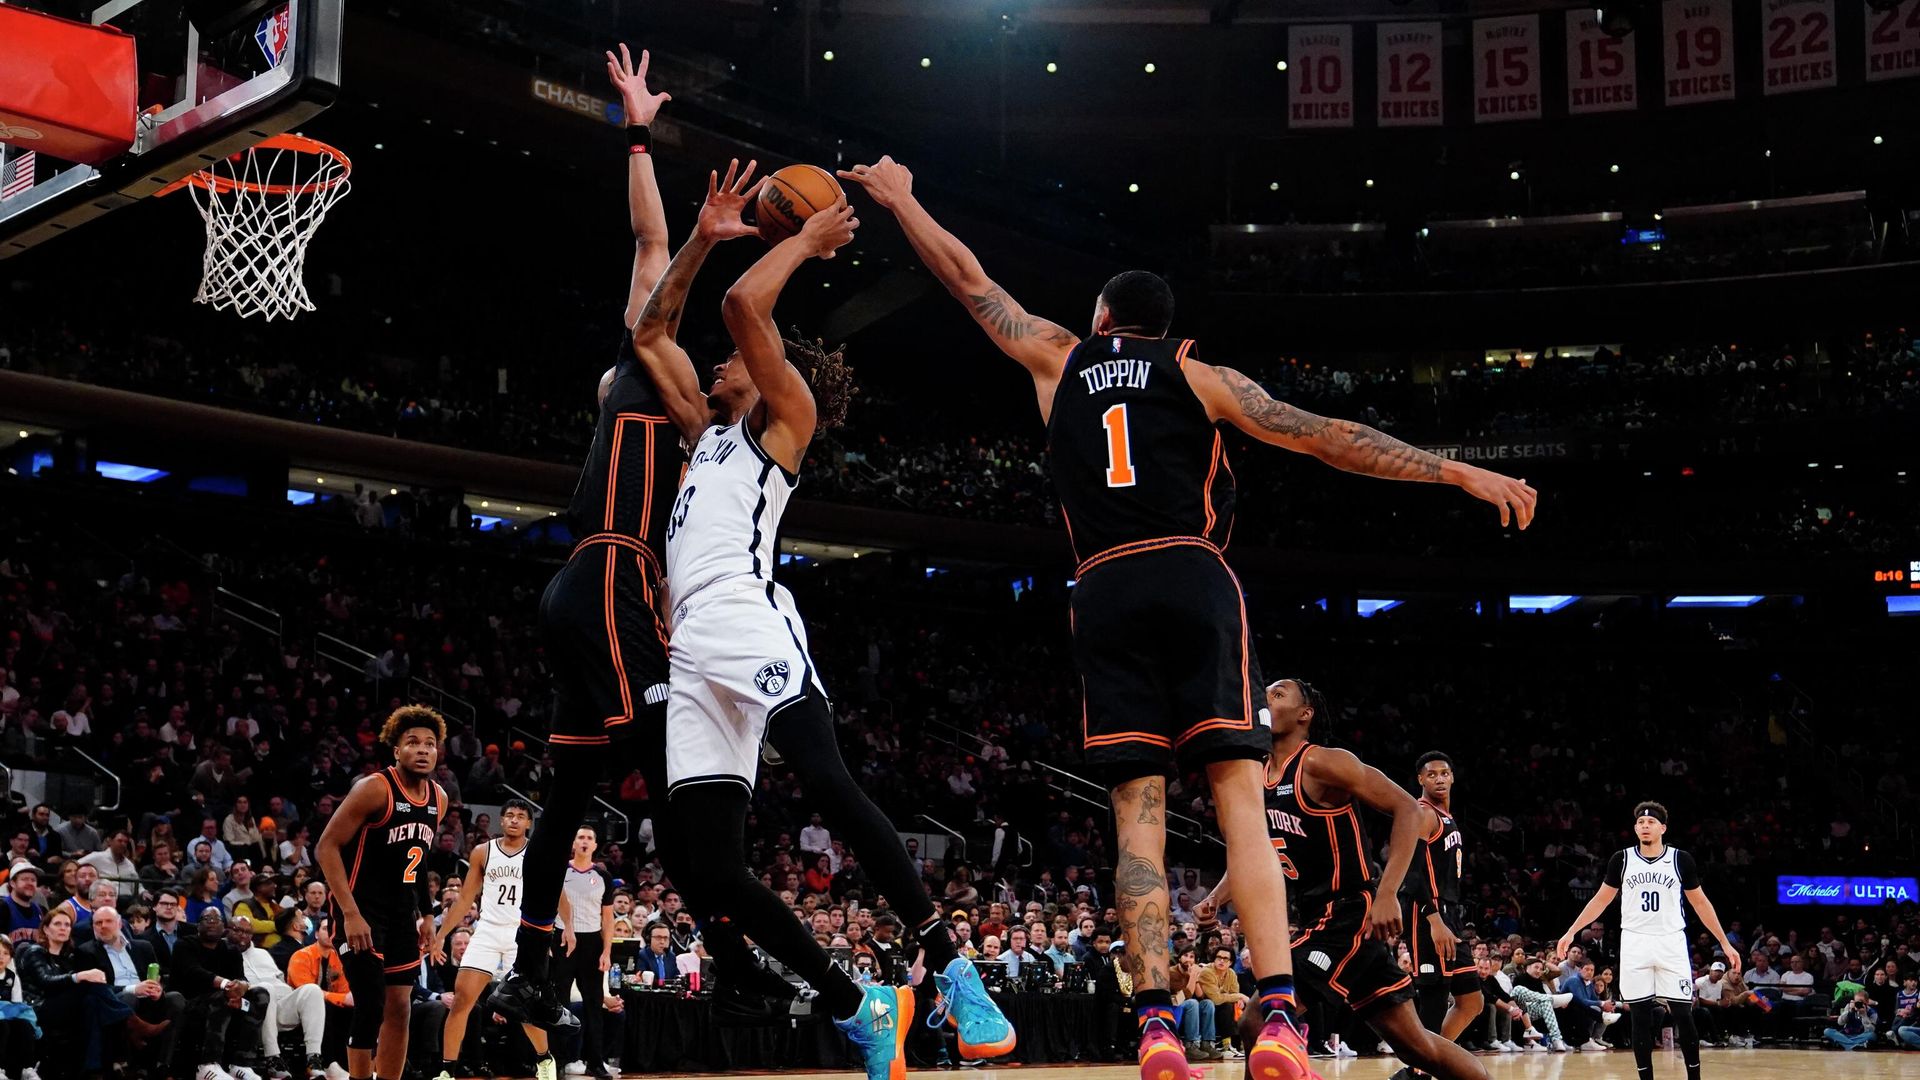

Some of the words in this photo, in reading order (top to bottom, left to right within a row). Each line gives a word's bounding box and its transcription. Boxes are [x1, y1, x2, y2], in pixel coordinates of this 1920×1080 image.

[1769, 11, 1829, 59] 22
[1579, 38, 1623, 79] 15
[1675, 27, 1721, 70] 19
[1300, 56, 1341, 94] 10
[1388, 53, 1430, 92] 12
[1485, 47, 1528, 88] 15
[1768, 61, 1833, 86] KNICKS
[534, 79, 602, 116] CHASE
[1572, 85, 1633, 106] KNICKS
[1668, 74, 1731, 97] KNICKS
[1293, 102, 1350, 120] KNICKS
[1381, 100, 1439, 119] KNICKS
[1478, 94, 1537, 115] KNICKS
[1079, 359, 1151, 394] TOPPIN
[1102, 403, 1136, 487] 1
[1464, 446, 1509, 460] BLUE
[1512, 443, 1567, 458] SEATS
[755, 662, 788, 689] NETS
[387, 823, 417, 845] NEW
[1267, 809, 1307, 837] YORK
[403, 847, 423, 883] 2
[487, 866, 523, 883] BROOKL
[1625, 872, 1676, 890] BROOKLYN
[1786, 884, 1841, 897] Michelob
[1854, 885, 1909, 899] ULTRA
[498, 884, 516, 906] 24
[1641, 891, 1660, 912] 30
